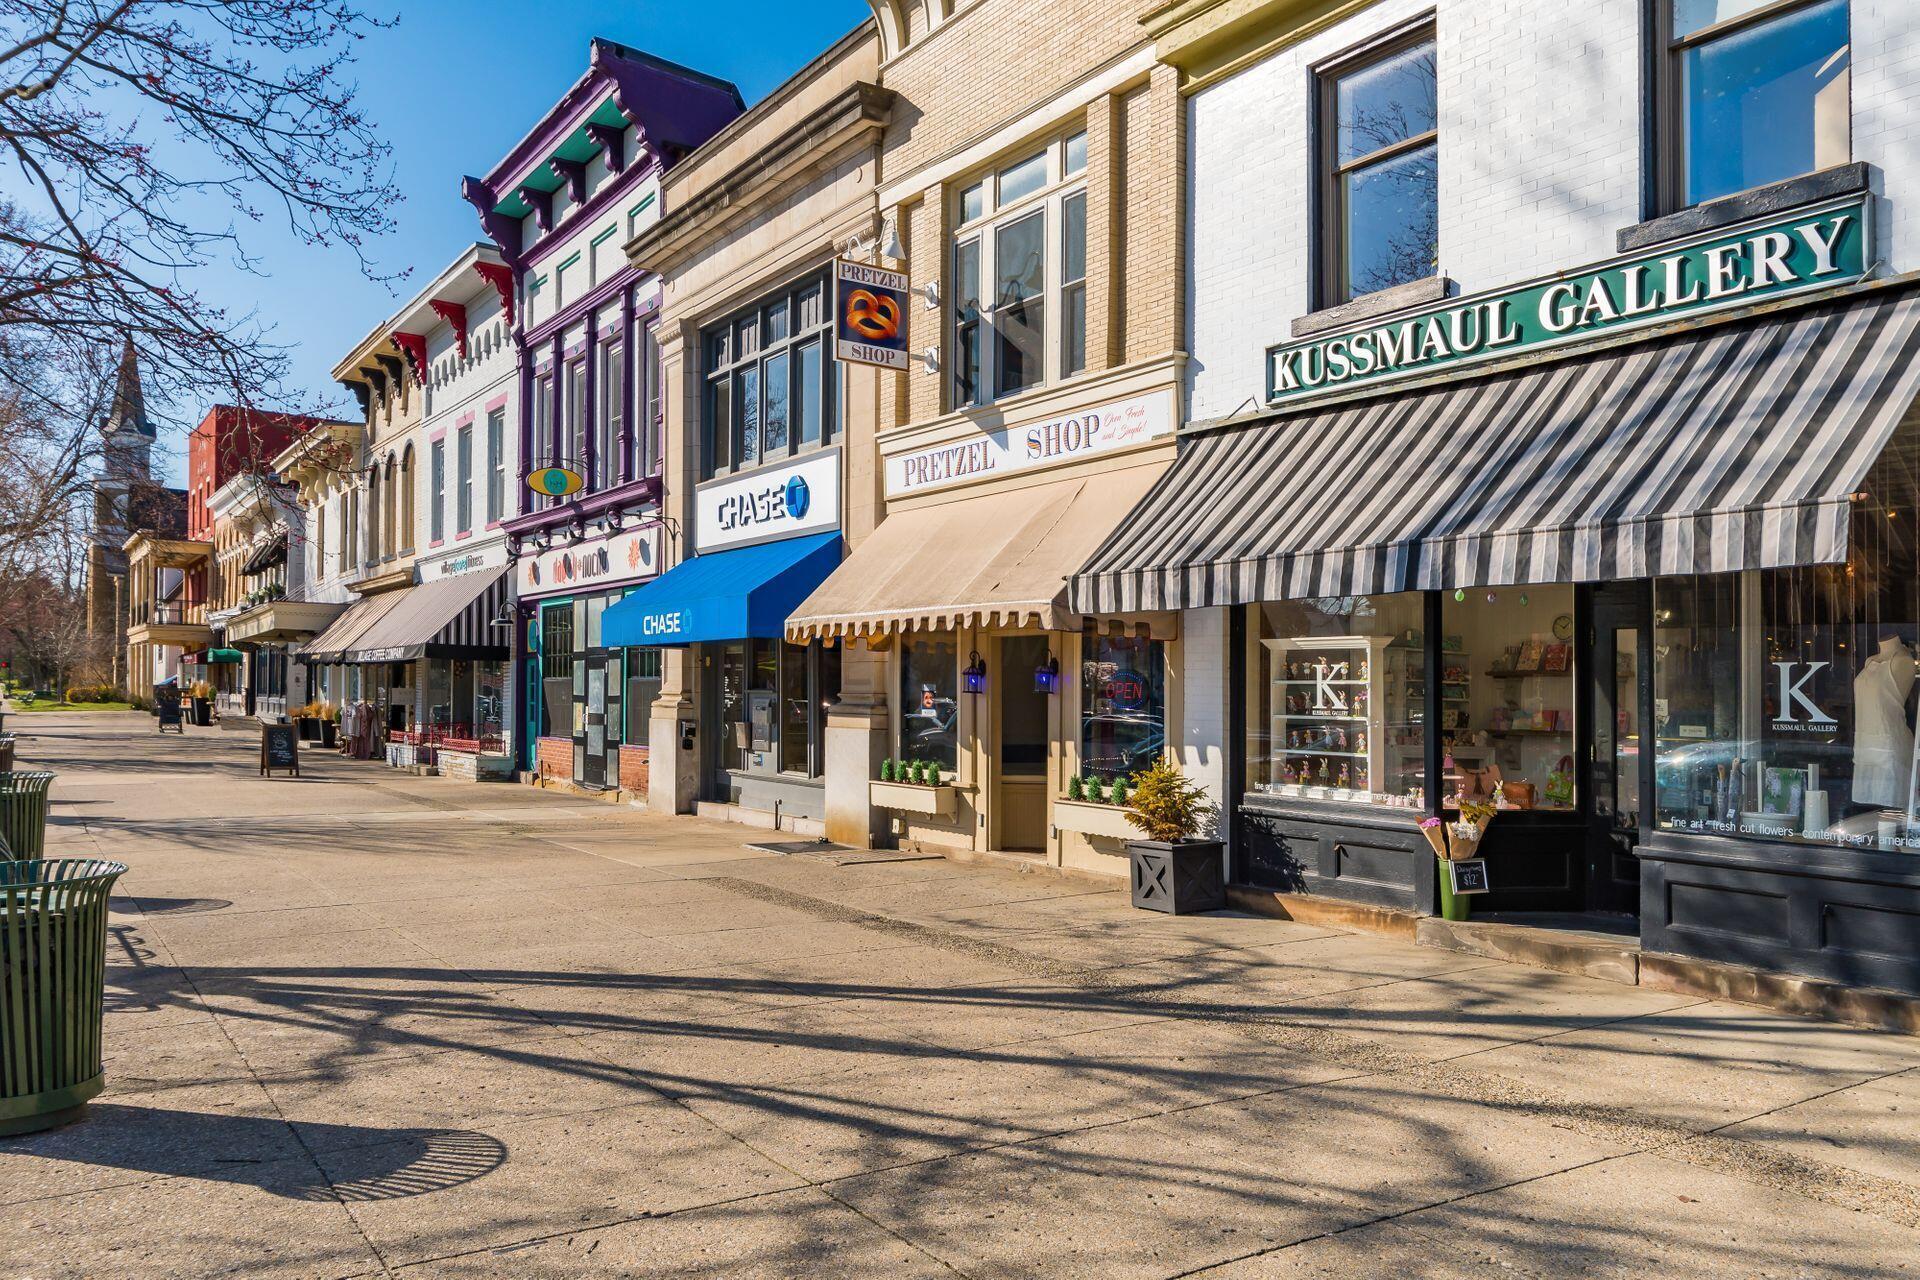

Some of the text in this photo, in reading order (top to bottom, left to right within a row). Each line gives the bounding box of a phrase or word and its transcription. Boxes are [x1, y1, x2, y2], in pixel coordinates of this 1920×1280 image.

[840, 263, 907, 291] PRETZEL
[1273, 215, 1852, 392] KUSSMAUL GALLERY
[851, 344, 895, 365] SHOP
[903, 414, 1101, 488] PRETZEL SHOP
[718, 484, 787, 531] CHASE
[643, 612, 681, 635] CHASE
[1106, 682, 1142, 699] OPEN
[1312, 664, 1349, 709] K
[1772, 661, 1838, 722] K
[1808, 724, 1838, 732] GALLERY
[1671, 816, 1687, 829] fine
[1690, 819, 1704, 830] art
[1712, 820, 1737, 832] fresh
[1740, 822, 1756, 834] cut
[1759, 822, 1794, 837] flowers
[1802, 829, 1874, 846] contemporary
